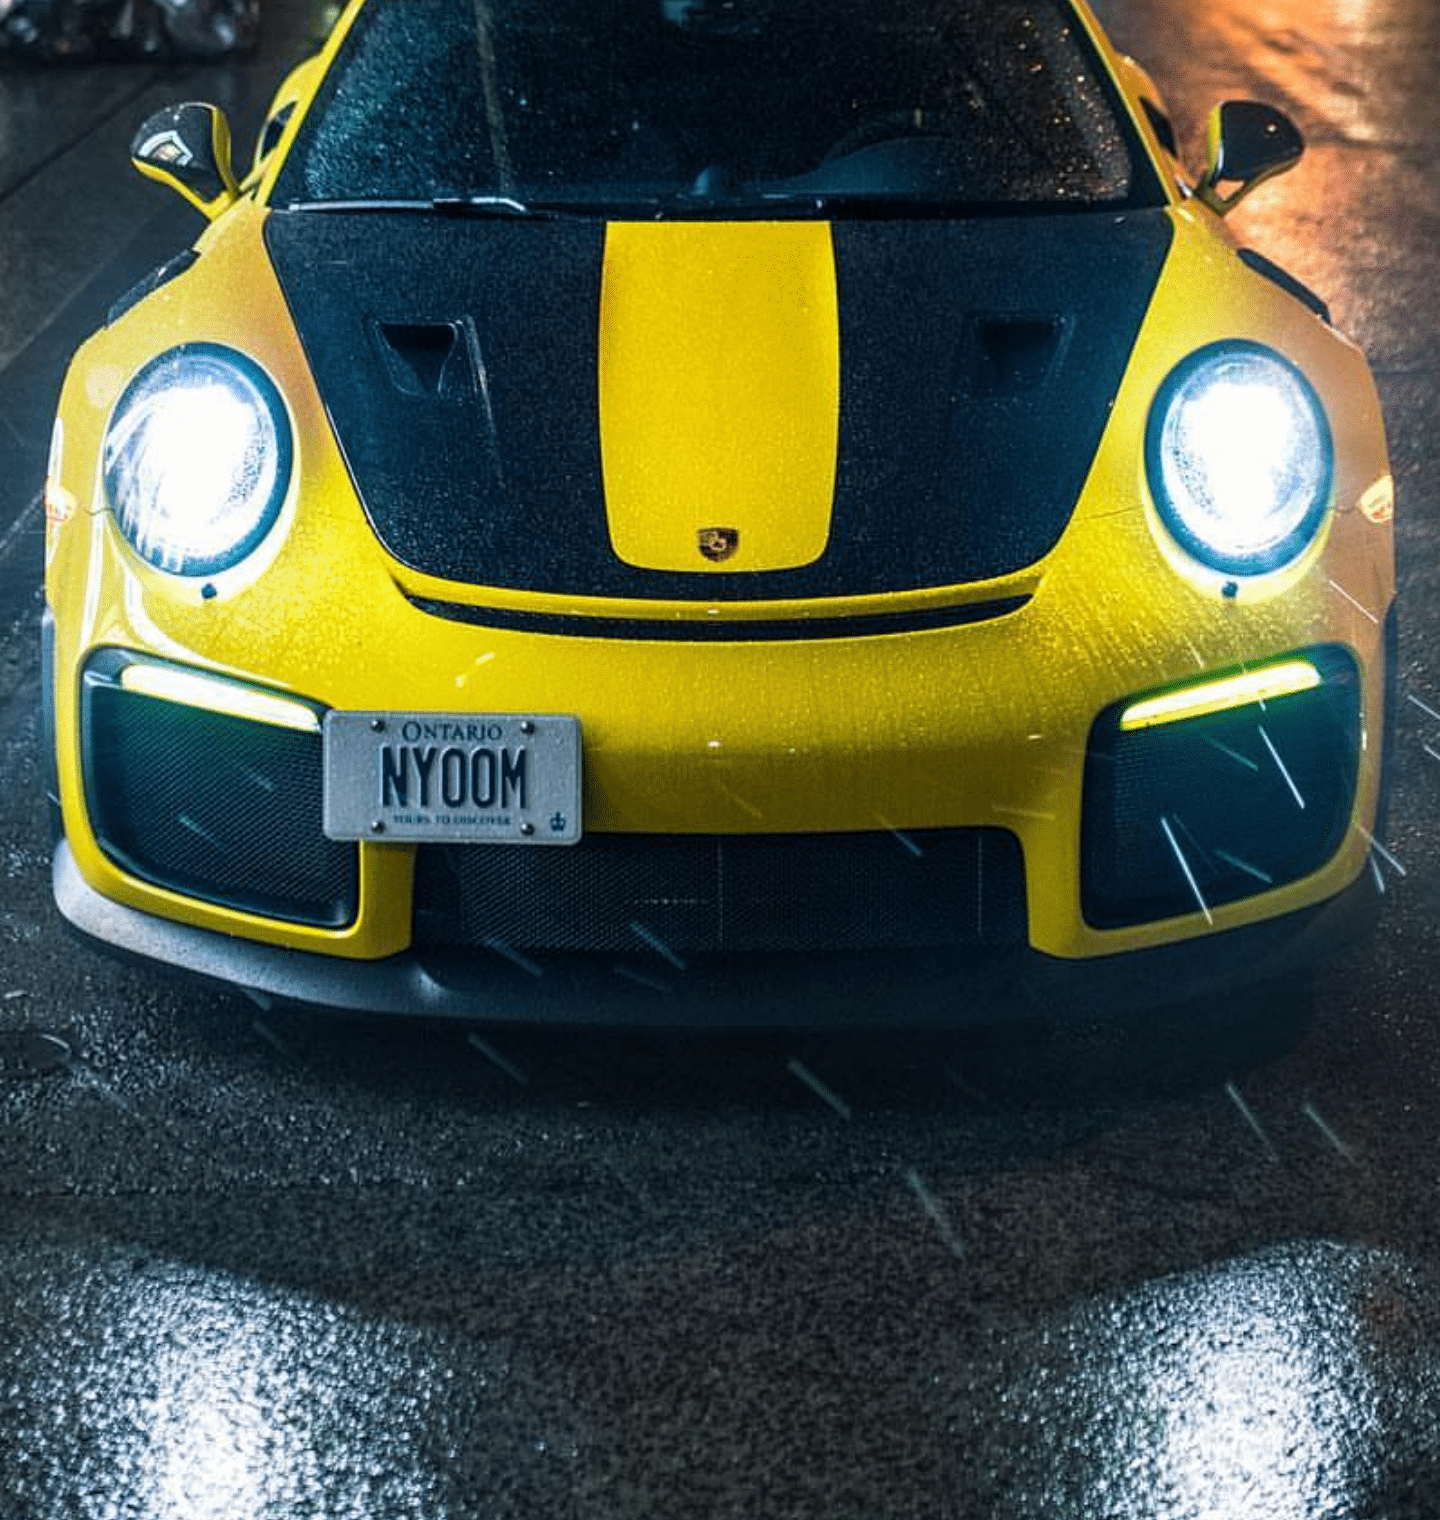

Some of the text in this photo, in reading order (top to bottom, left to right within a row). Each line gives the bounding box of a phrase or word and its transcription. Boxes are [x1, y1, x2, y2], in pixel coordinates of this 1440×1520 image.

[402, 721, 502, 742] ONTARIO
[381, 746, 526, 808] NYOOM
[436, 815, 450, 825] TO
